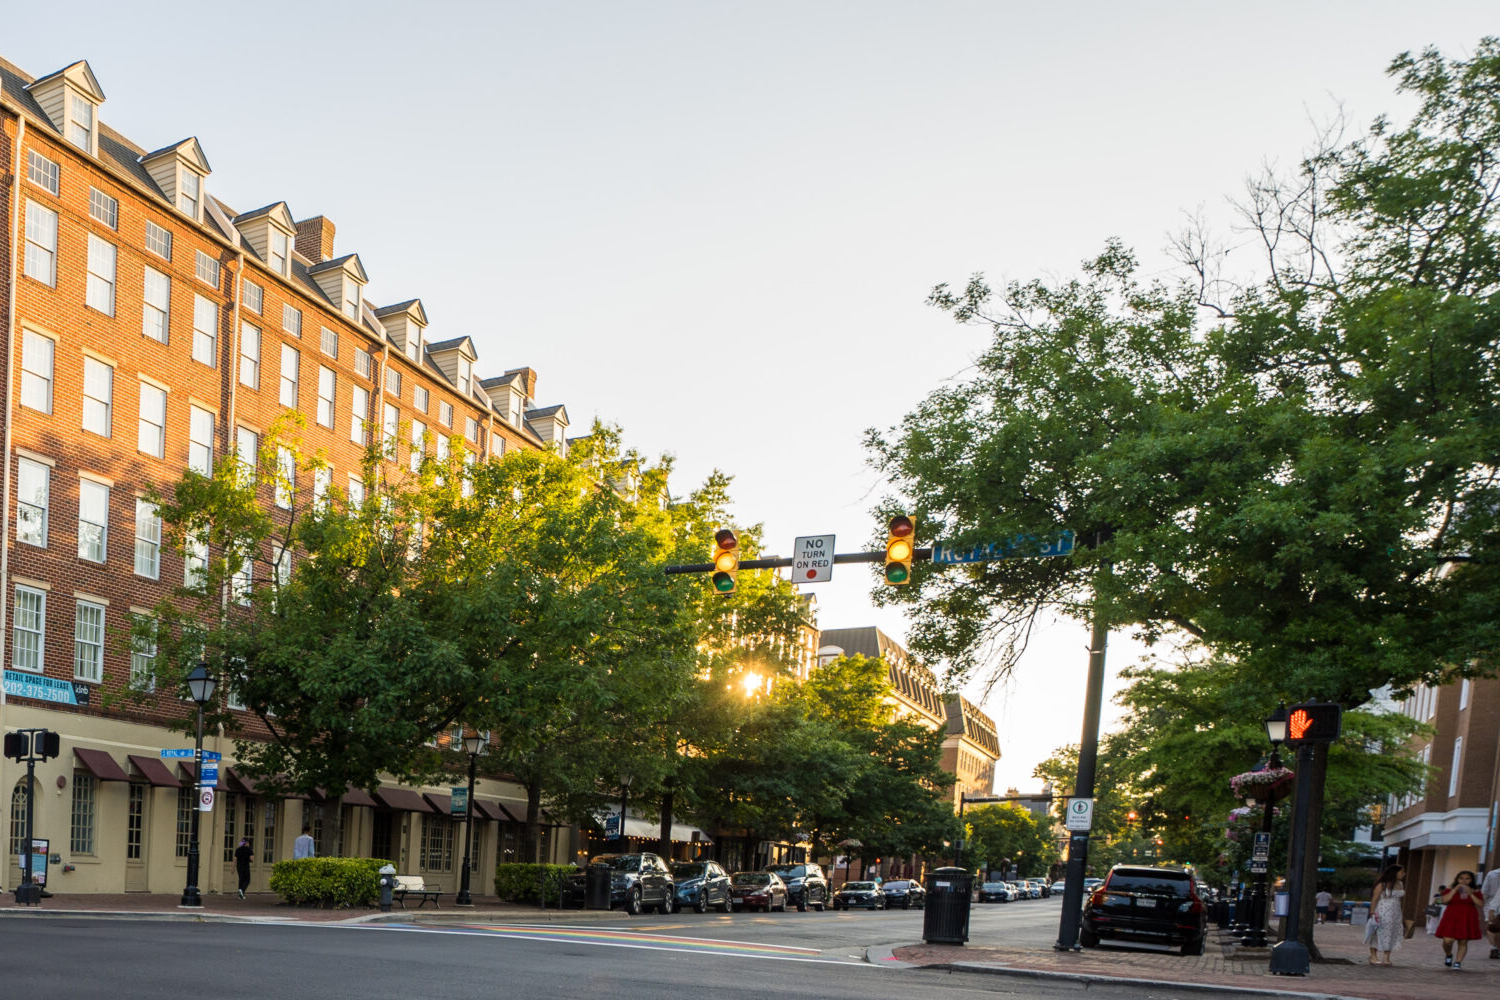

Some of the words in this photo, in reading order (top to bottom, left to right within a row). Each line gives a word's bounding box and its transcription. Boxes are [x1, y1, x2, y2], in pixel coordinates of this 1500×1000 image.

[806, 539, 823, 549] NO
[802, 550, 825, 559] TURN
[796, 561, 809, 569] ON
[811, 559, 829, 568] RED
[5, 671, 23, 682] RETAIL
[25, 675, 42, 686] SPACE
[43, 678, 53, 687] FOR
[54, 680, 70, 691] LEASE
[4, 681, 70, 703] 202-375-7500
